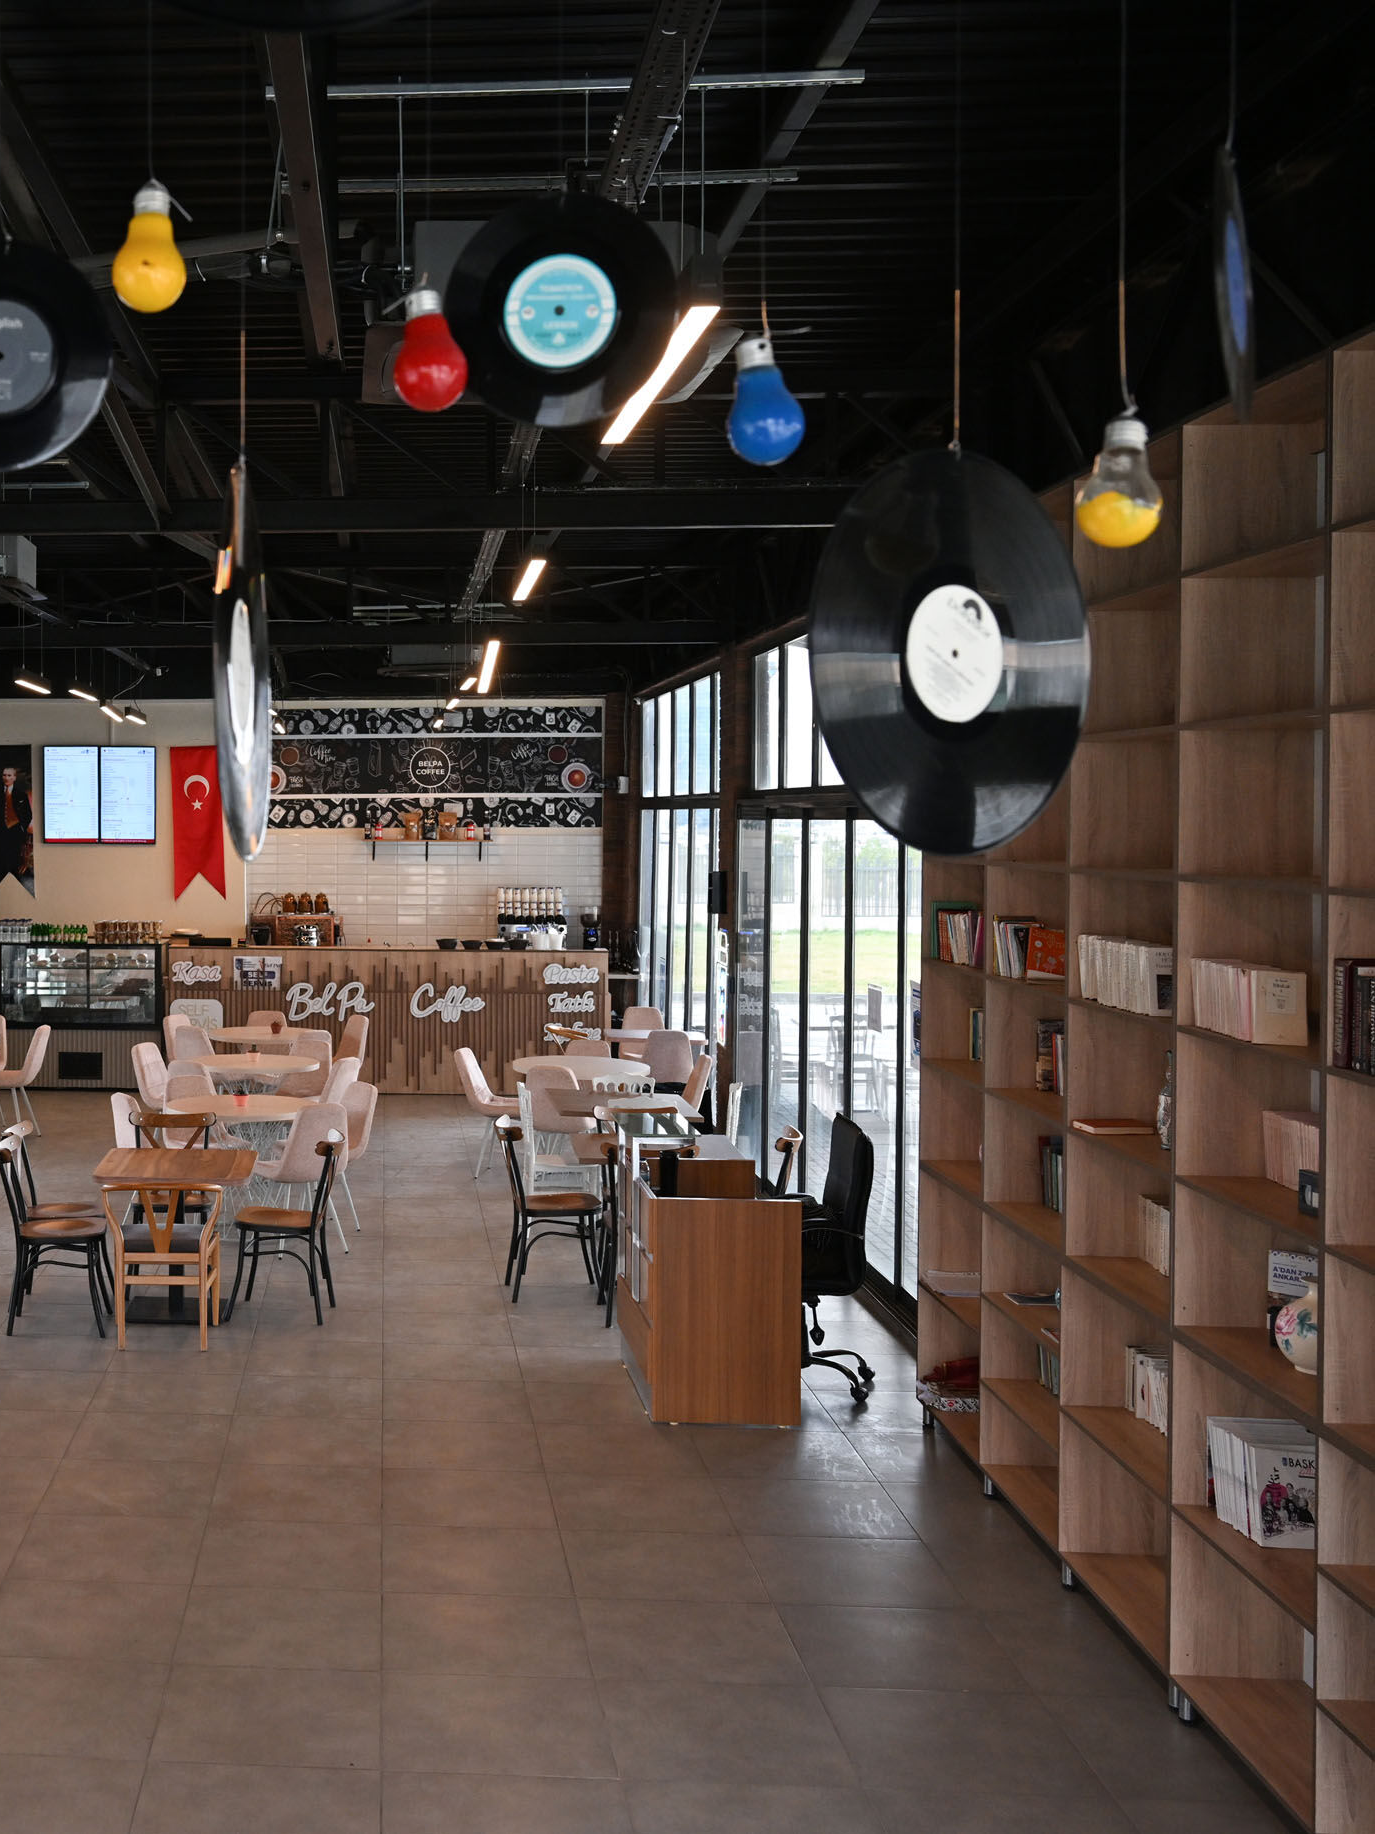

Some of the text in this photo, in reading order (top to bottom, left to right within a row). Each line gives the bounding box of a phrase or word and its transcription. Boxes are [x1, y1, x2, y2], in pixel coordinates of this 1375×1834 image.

[415, 768, 445, 776] COFFEE
[172, 961, 222, 985] Kasa
[543, 963, 600, 984] Pasta
[178, 1004, 210, 1016] SELF
[410, 982, 485, 1023] Coffee
[1334, 965, 1344, 1055] HEMINGWAY
[1273, 1273, 1302, 1282] ANKAR
